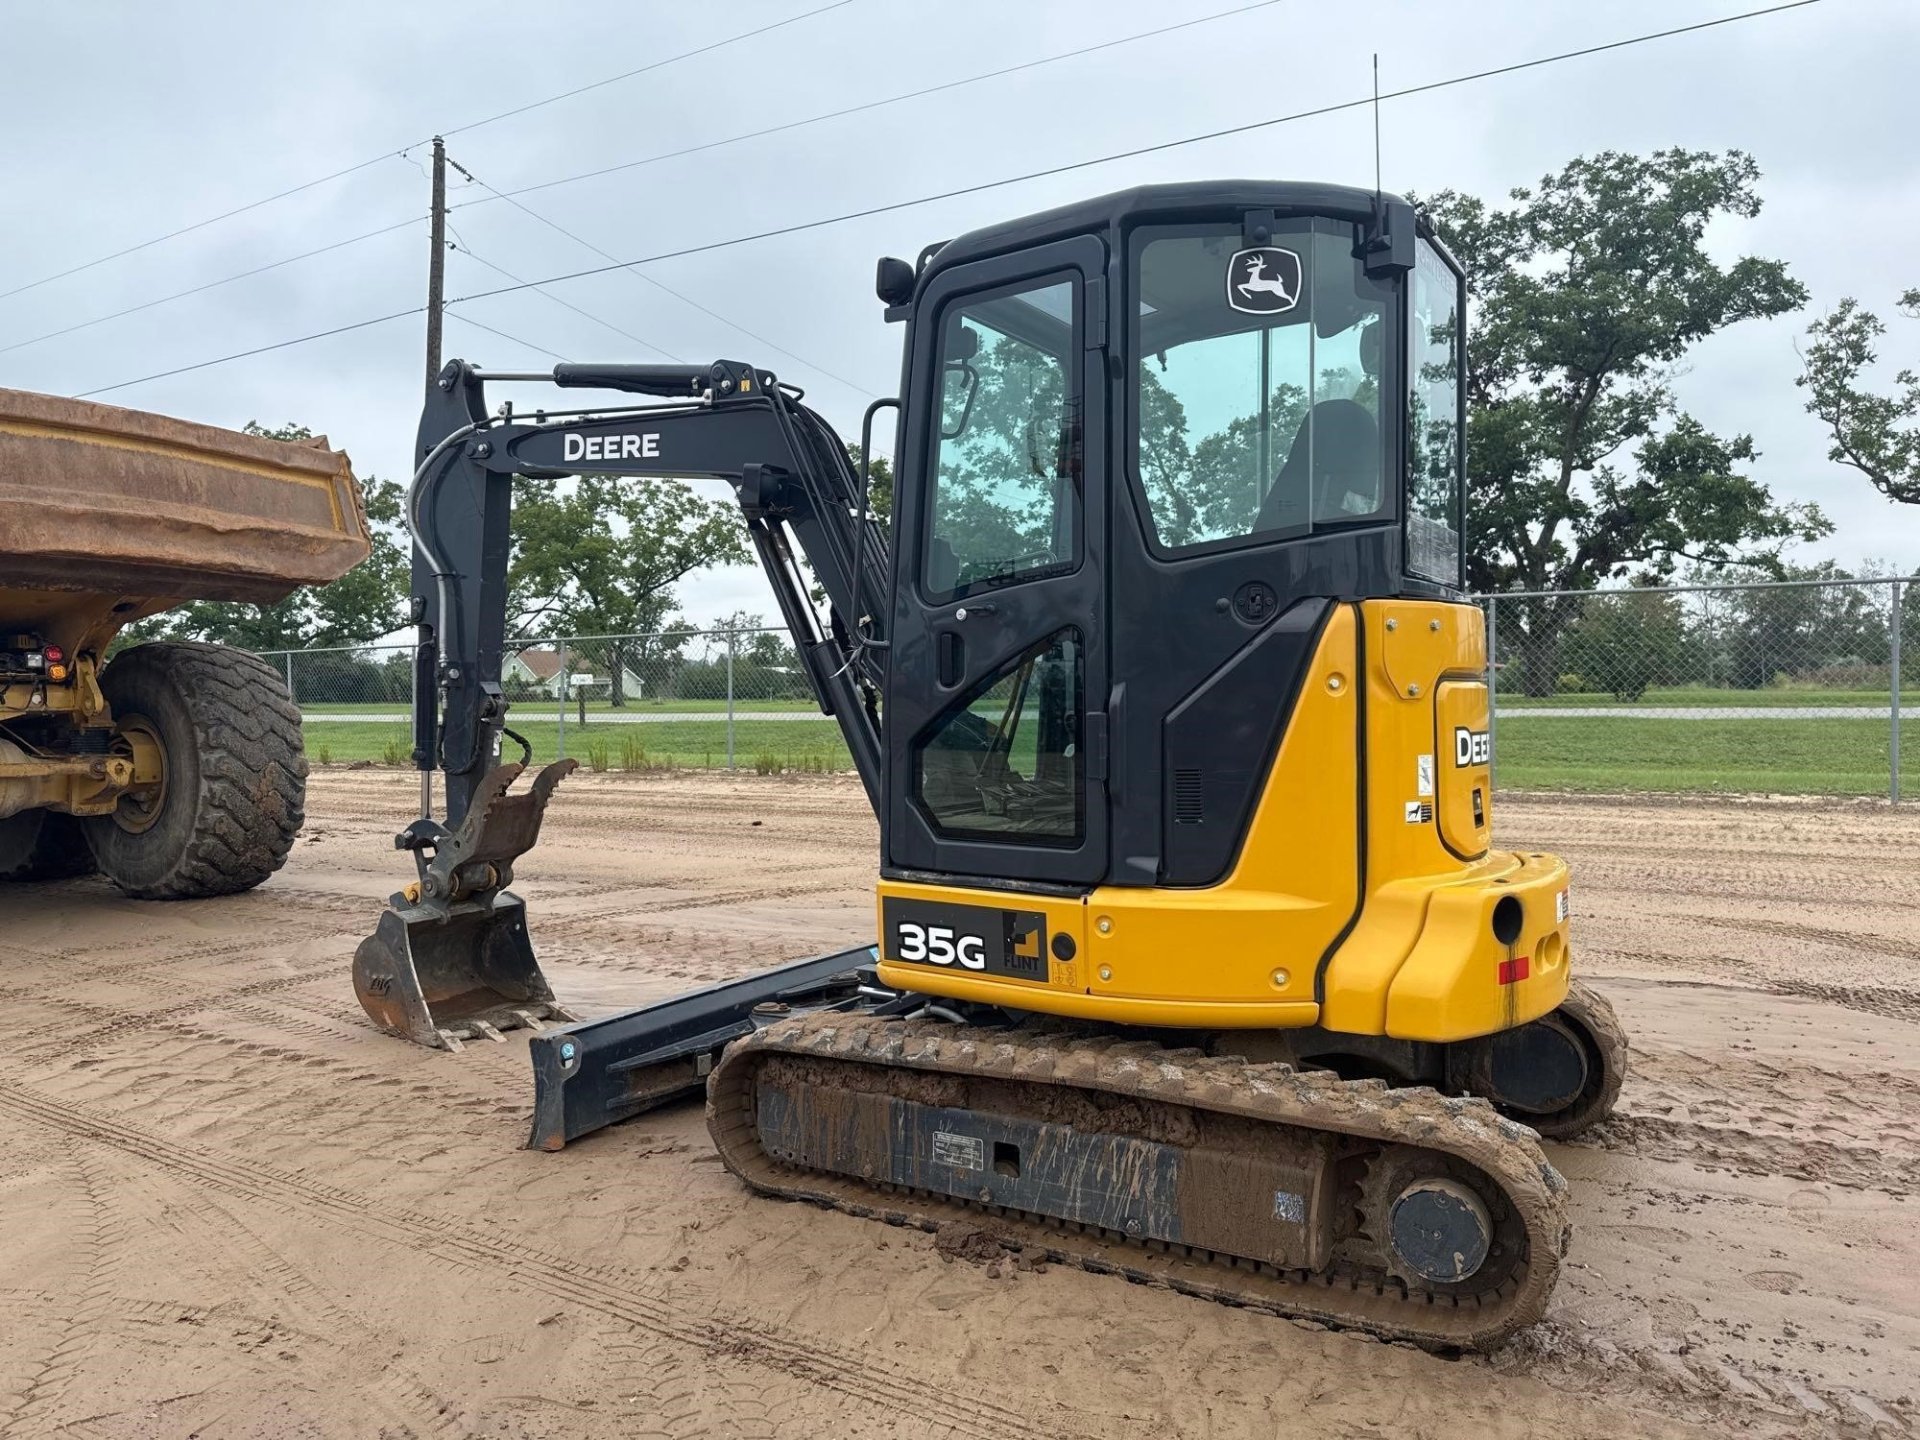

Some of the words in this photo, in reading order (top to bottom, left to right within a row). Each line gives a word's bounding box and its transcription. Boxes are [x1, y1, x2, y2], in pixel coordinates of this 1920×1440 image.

[563, 432, 660, 462] DEERE
[899, 923, 986, 970] 35G
[1004, 954, 1040, 971] FLINT
